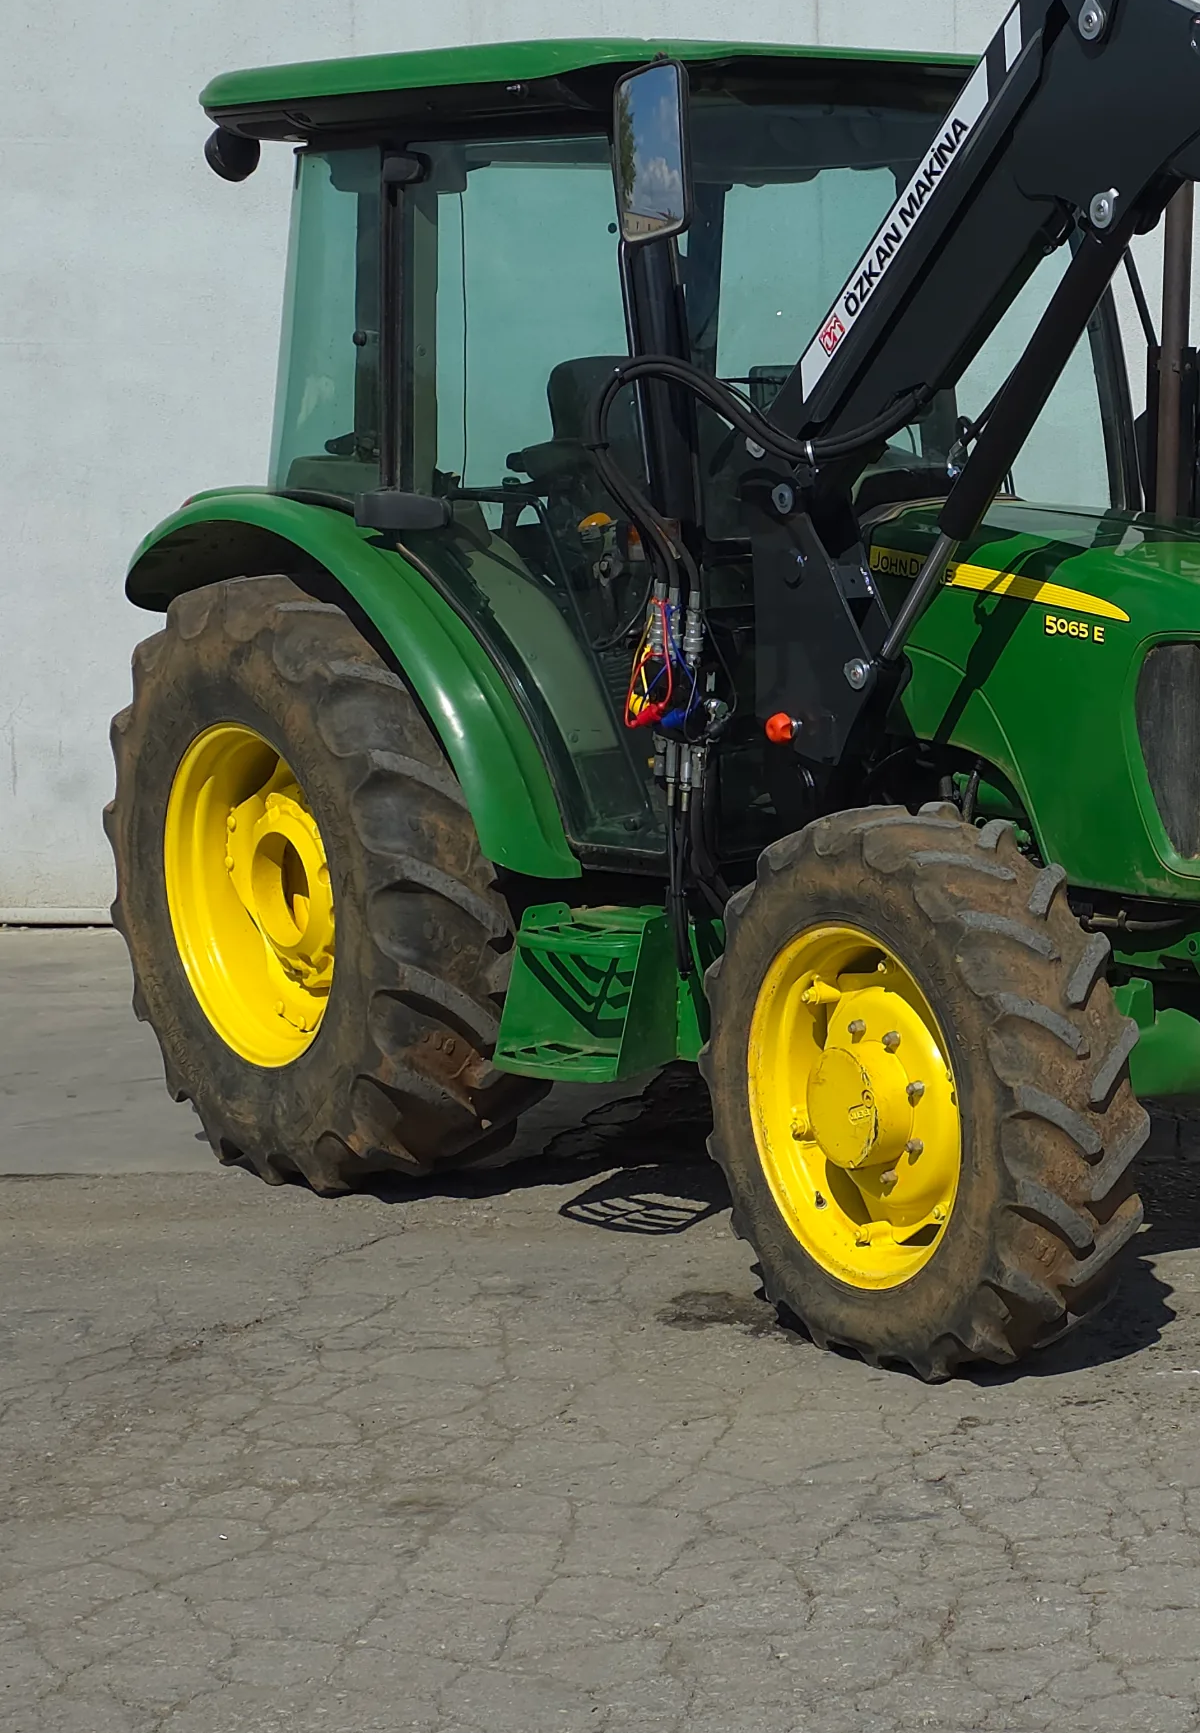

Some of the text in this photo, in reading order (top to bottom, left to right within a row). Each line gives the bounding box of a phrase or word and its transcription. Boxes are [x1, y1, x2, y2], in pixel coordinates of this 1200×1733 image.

[844, 223, 903, 317] ÖZKAN
[898, 118, 969, 228] MAKİNA
[1044, 614, 1105, 644] 5065 E
